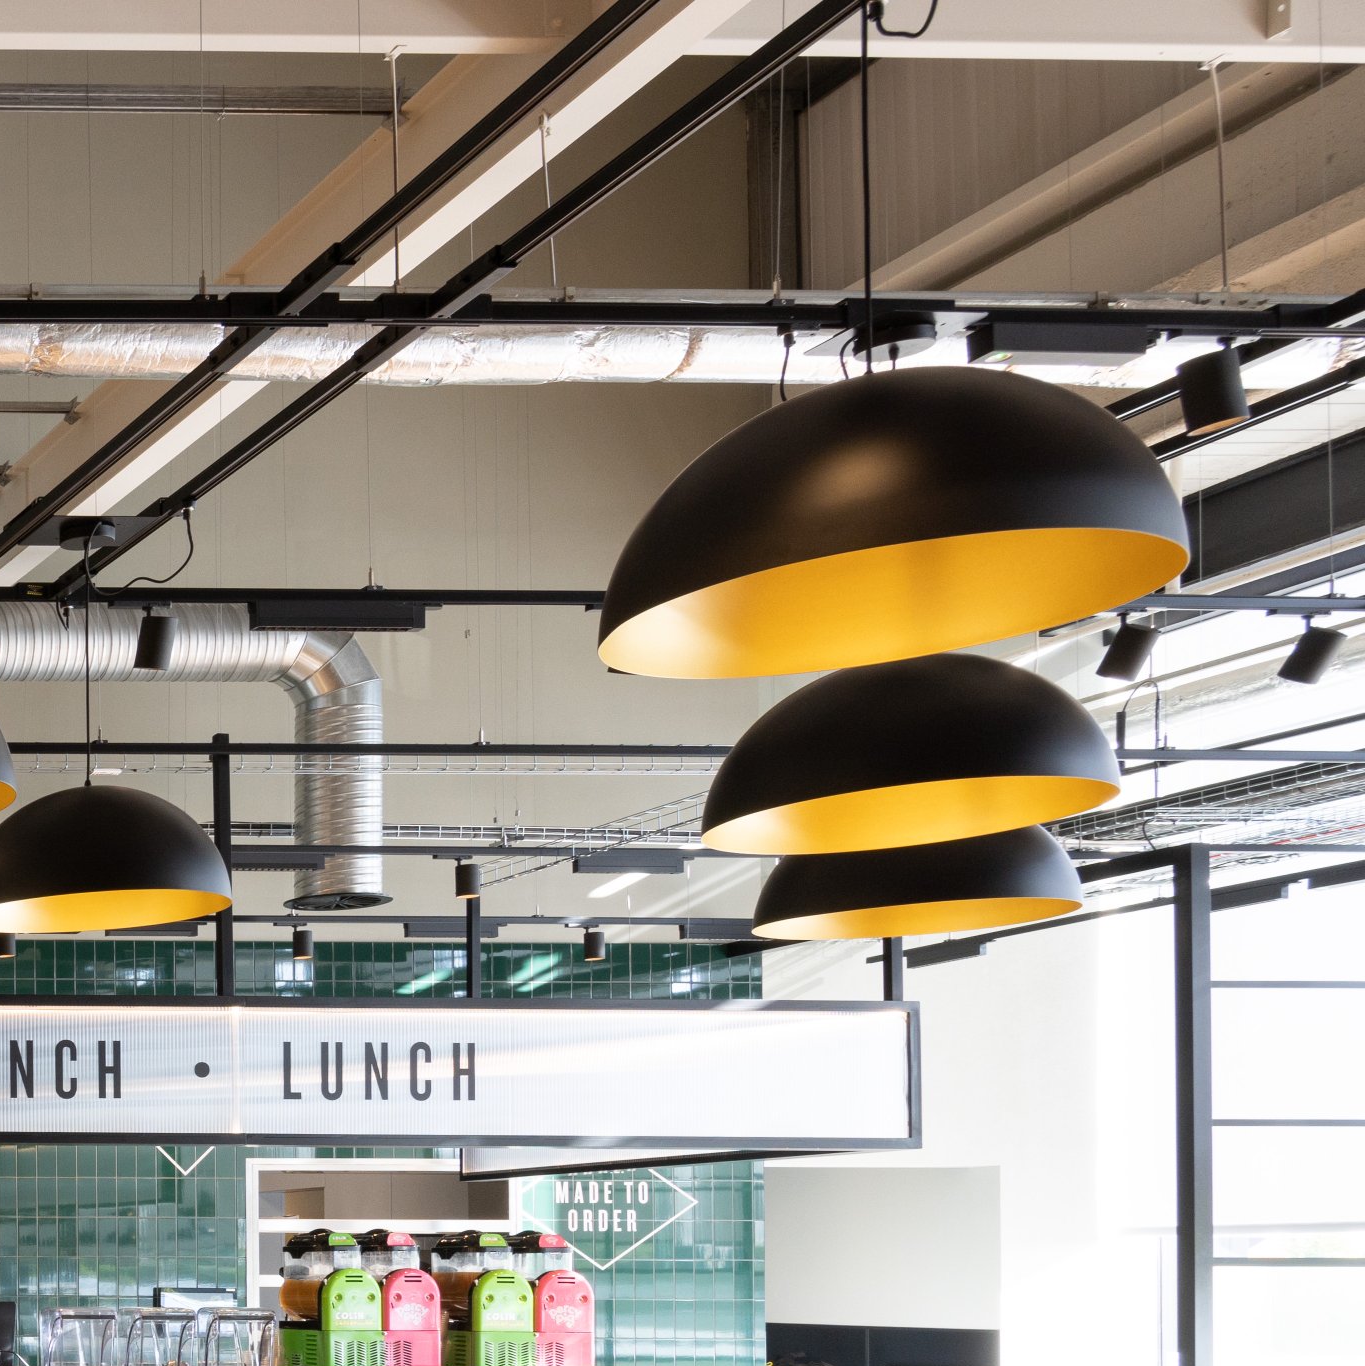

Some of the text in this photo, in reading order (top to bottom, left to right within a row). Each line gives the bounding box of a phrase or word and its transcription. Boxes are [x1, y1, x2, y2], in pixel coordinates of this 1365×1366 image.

[283, 1041, 476, 1102] LUNCH
[555, 1181, 649, 1204] MADE TO
[568, 1209, 638, 1232] ORDER
[485, 1312, 516, 1320] COLIN
